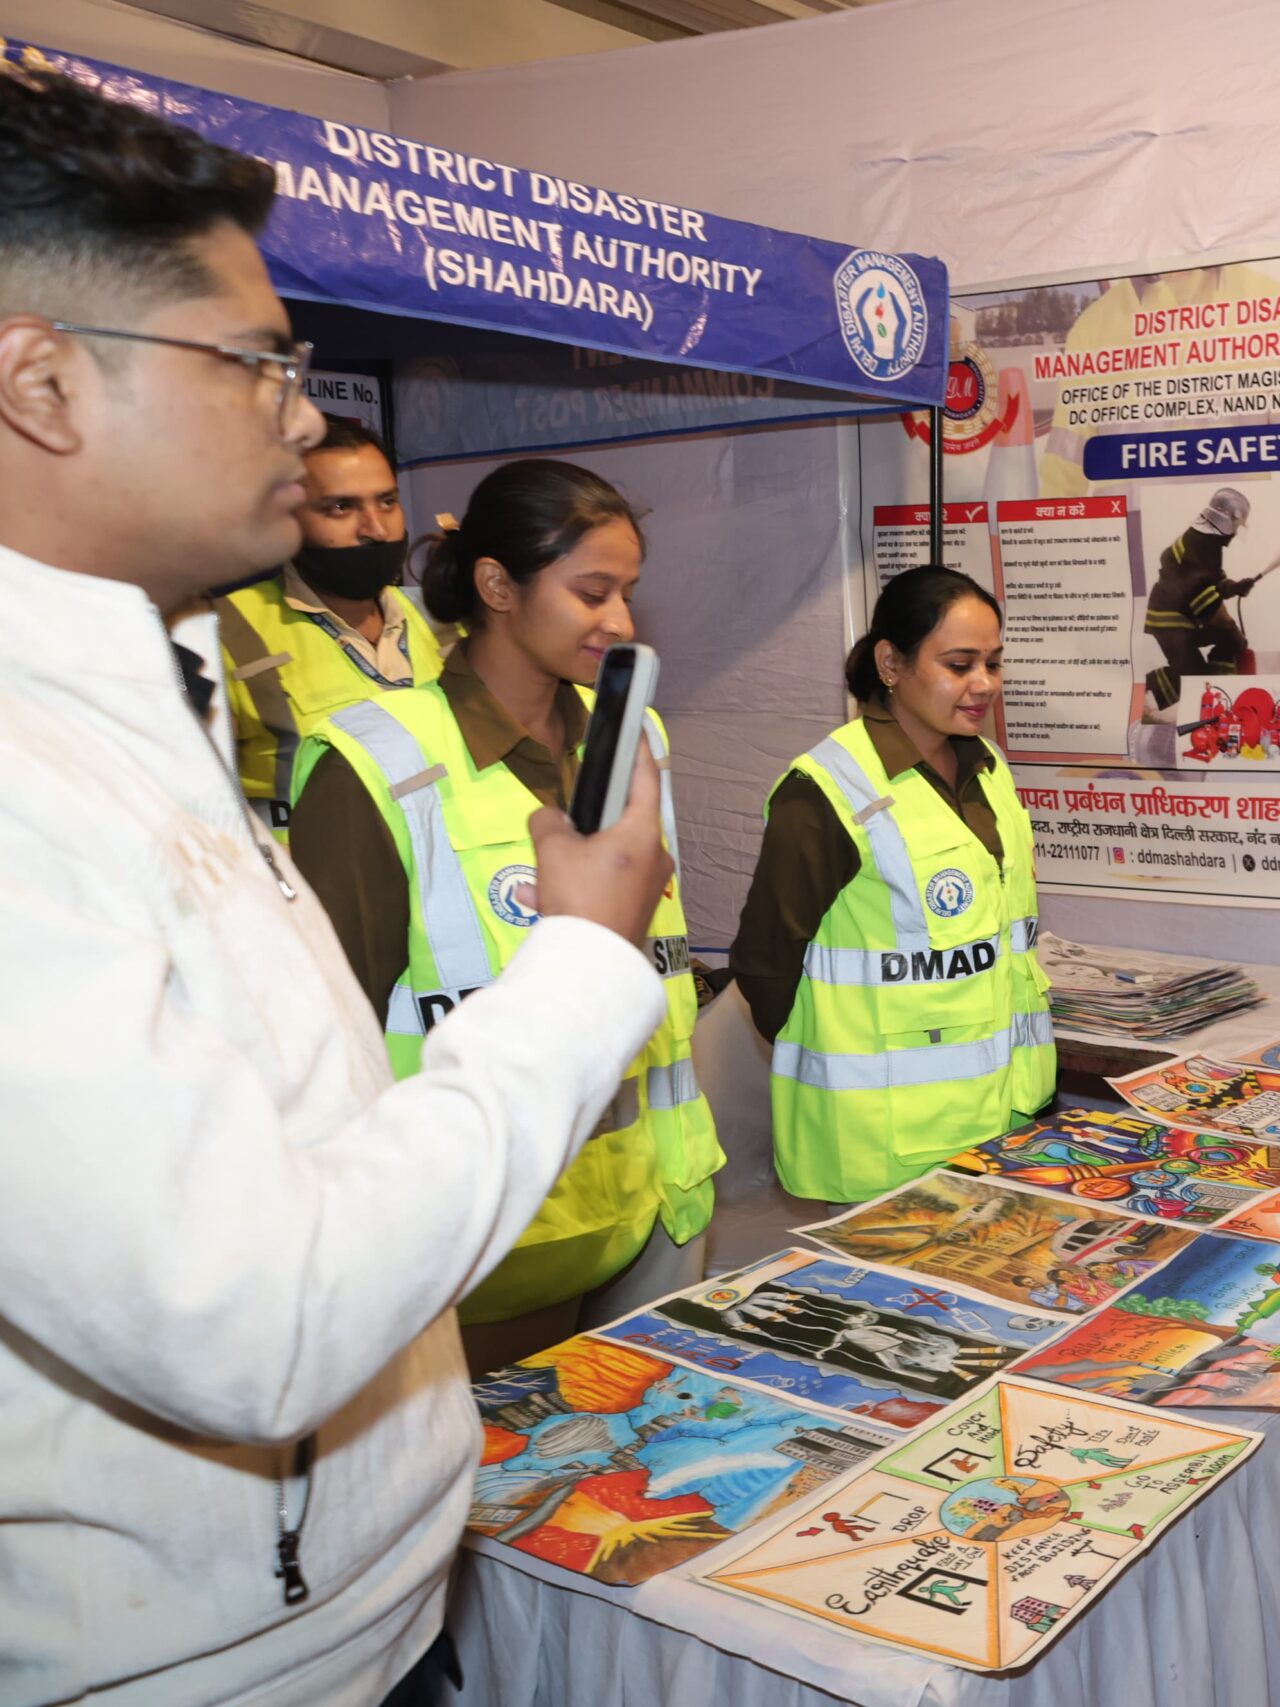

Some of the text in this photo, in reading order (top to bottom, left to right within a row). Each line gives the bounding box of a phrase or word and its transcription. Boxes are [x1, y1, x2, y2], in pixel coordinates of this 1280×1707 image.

[322, 119, 708, 242] DISTRICT DISASTER
[260, 160, 763, 297] MANAGEMENT AUTHORITY
[424, 246, 653, 331] (SHAHDARA)
[838, 252, 924, 375] DELHI DISASTER MANAGEMENT AUTHORITY
[1135, 303, 1230, 337] DISTRICT
[1035, 342, 1180, 379] MANAGEMENT
[302, 378, 379, 405] LINE No.
[1062, 386, 1109, 405] OFFICE
[1112, 384, 1130, 400] OF
[1134, 380, 1162, 397] THE
[1167, 374, 1233, 395] DISTRICT
[1069, 410, 1087, 425] DC
[1091, 405, 1140, 423] OFFICE
[1144, 399, 1219, 419] COMPLEX,
[1223, 394, 1267, 413] NAND
[1121, 441, 1187, 469] FIRE
[1035, 505, 1056, 517] क्या
[1057, 505, 1067, 516] न
[1063, 783, 1126, 814] प्रबंधन
[1130, 786, 1231, 819] प्राधिकरण
[1057, 818, 1090, 837] राष्ट्रीय
[1093, 822, 1138, 838] राजधानी
[1141, 823, 1159, 839] क्षेत्र
[1162, 824, 1195, 842] दिल्ली
[1247, 828, 1267, 846] नंद
[1034, 844, 1100, 861] 11-22111077
[1138, 849, 1226, 868] ddmashahdara
[881, 941, 996, 983] DMAD
[892, 1505, 928, 1533] DROP
[1002, 1538, 1031, 1559] KEEP
[1003, 1532, 1063, 1573] DISTANCE
